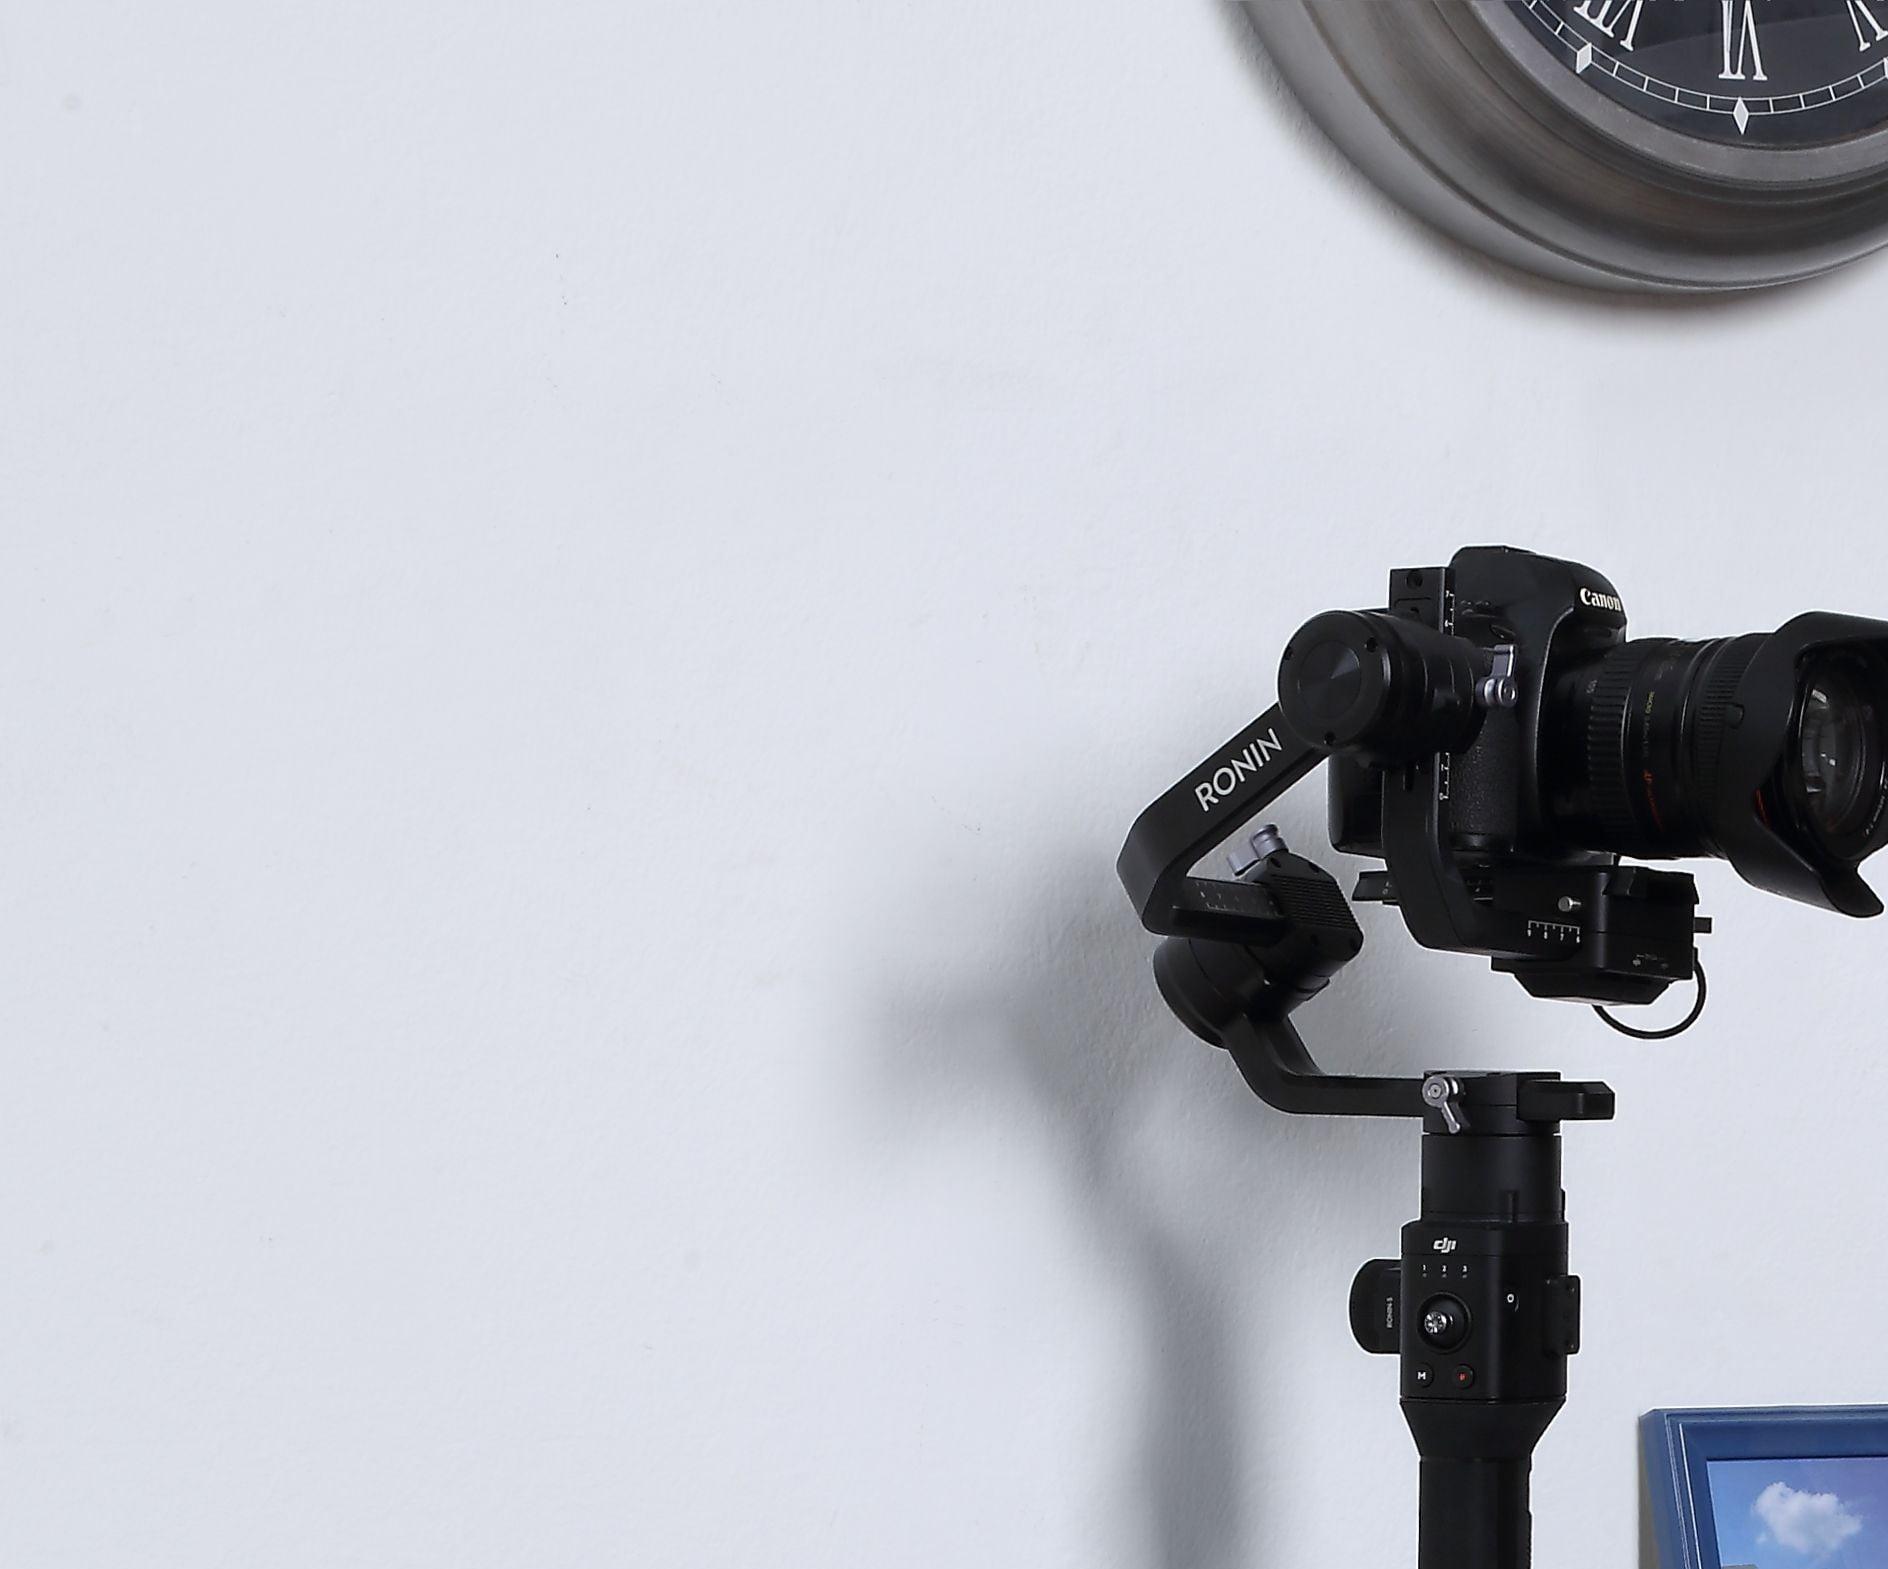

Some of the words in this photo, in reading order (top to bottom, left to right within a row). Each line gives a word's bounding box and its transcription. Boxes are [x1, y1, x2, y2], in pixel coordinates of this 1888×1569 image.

[1579, 587, 1622, 612] Canon
[1194, 727, 1283, 812] RONIN
[1417, 1371, 1427, 1381] M
